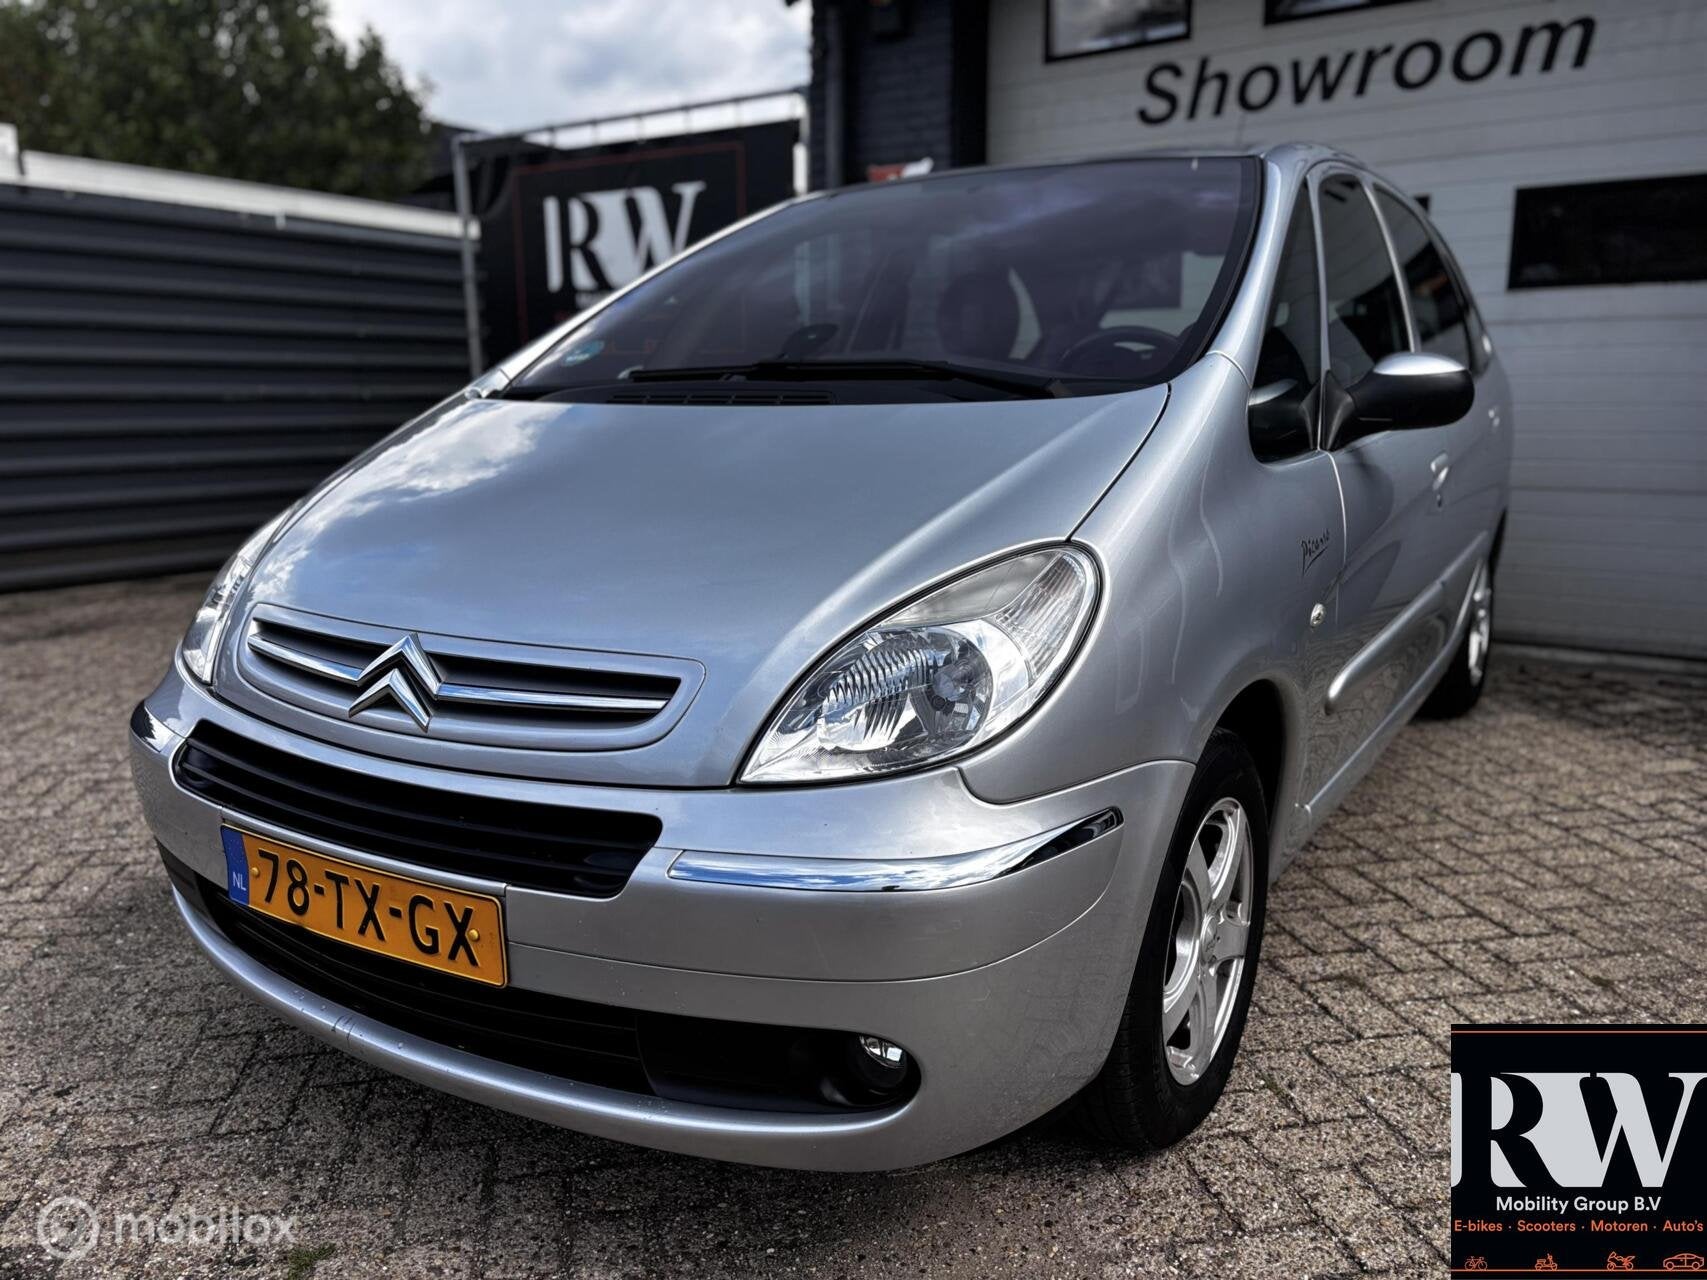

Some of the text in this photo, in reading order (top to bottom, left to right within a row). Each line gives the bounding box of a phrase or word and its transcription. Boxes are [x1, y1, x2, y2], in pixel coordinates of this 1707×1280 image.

[1138, 17, 1596, 125] Showroom
[543, 181, 706, 293] RW
[232, 873, 247, 891] NL
[258, 848, 480, 967] 78-TX-GX
